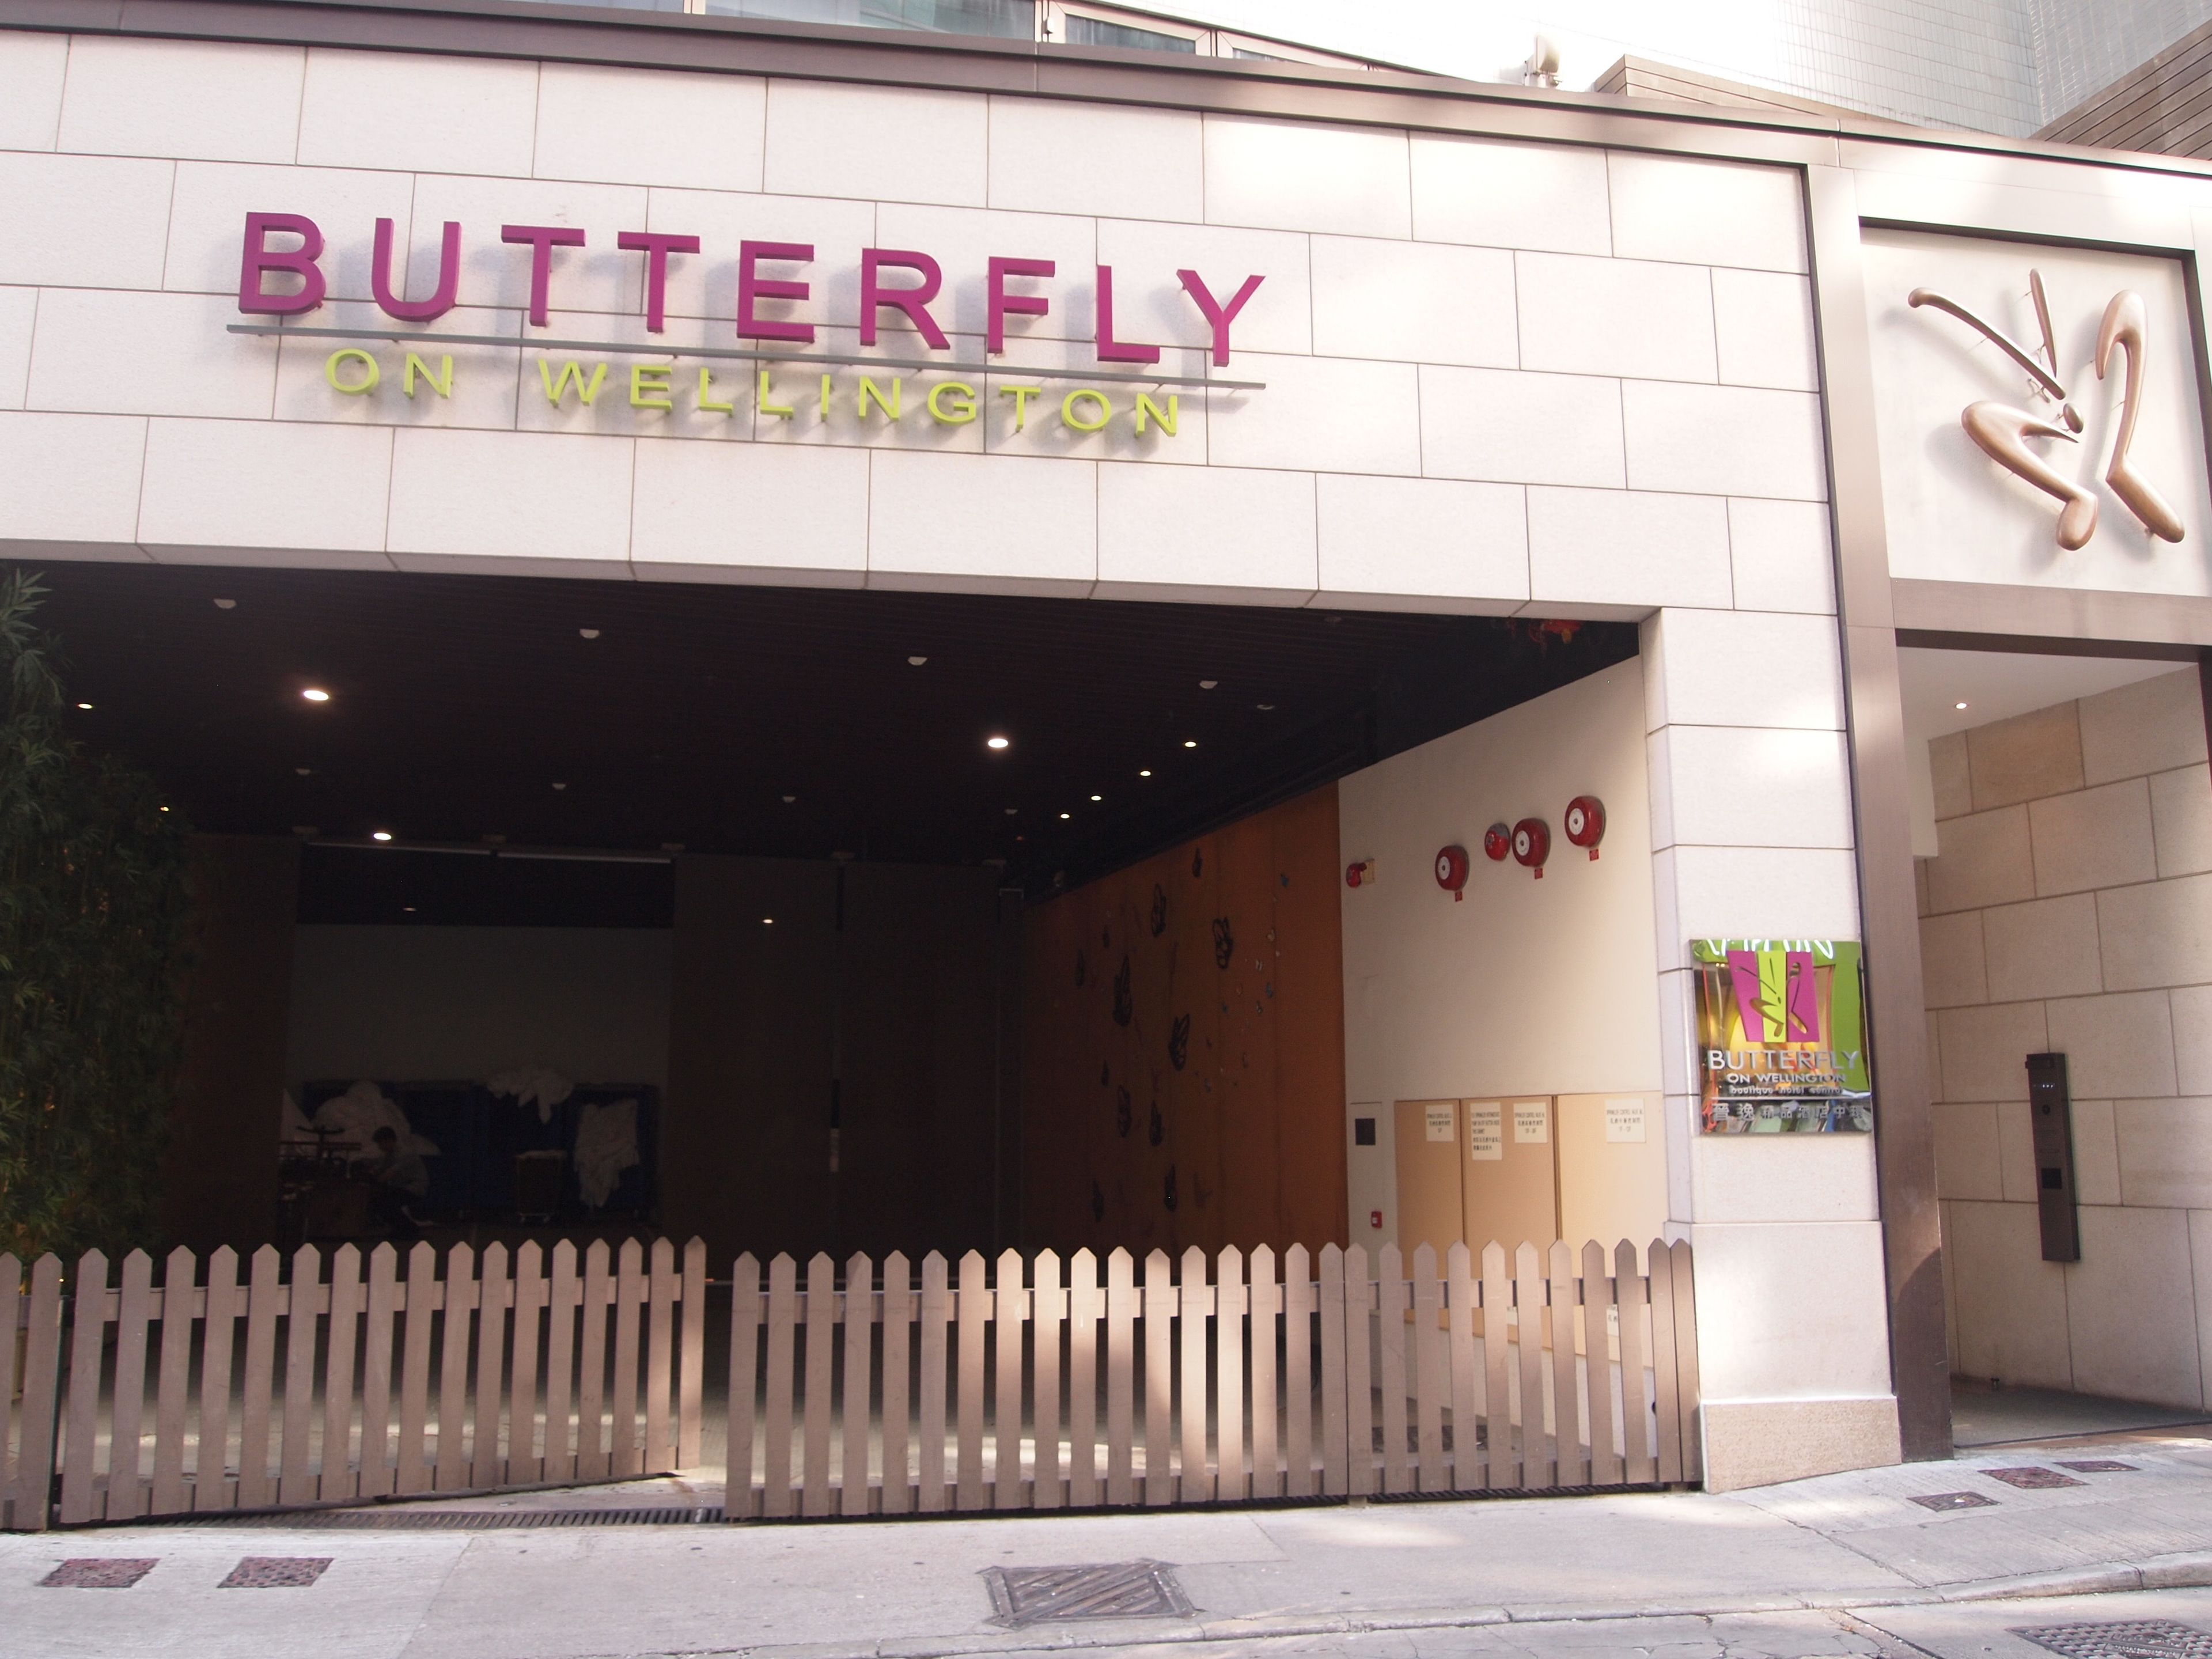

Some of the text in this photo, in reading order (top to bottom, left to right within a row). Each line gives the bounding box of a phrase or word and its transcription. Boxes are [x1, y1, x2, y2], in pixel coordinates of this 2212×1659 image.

[238, 212, 1266, 367] BUTTERFLY
[325, 348, 1179, 437] ON WELLINGTON
[1707, 1050, 1859, 1070] BUTTERFLY
[1726, 1073, 1846, 1084] ON WELLINGTON
